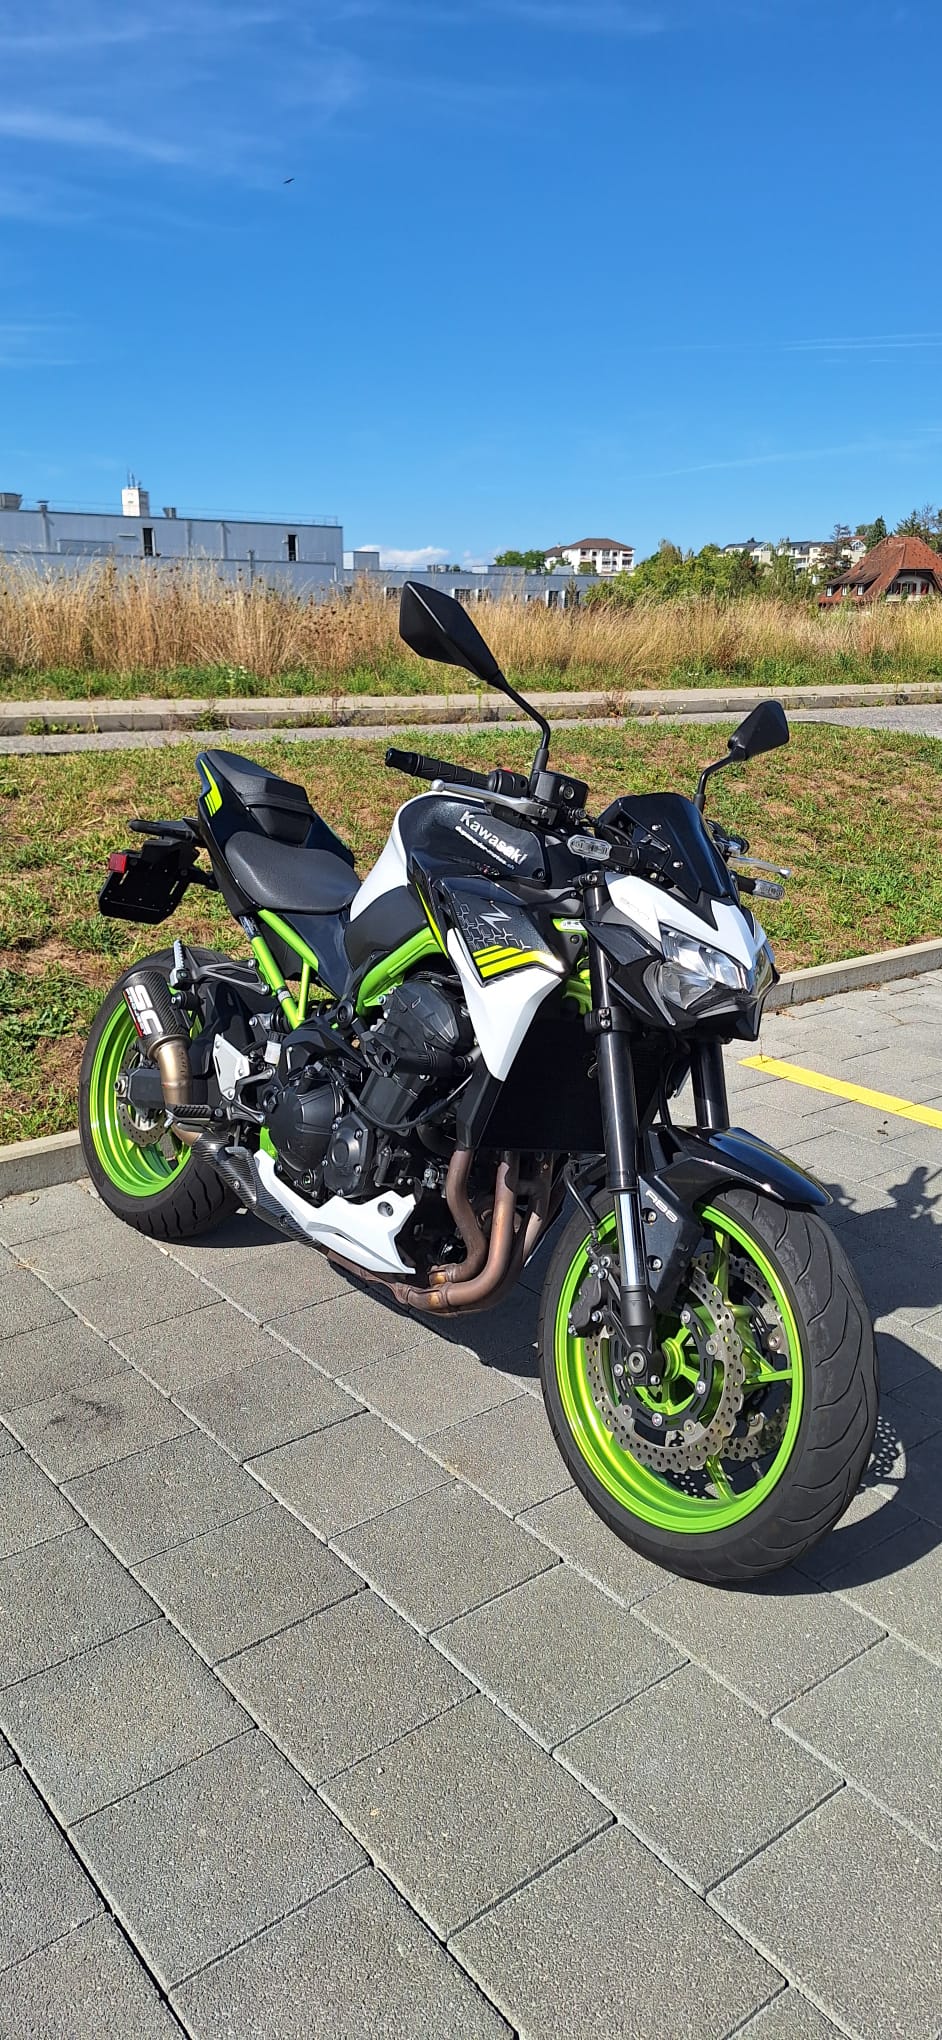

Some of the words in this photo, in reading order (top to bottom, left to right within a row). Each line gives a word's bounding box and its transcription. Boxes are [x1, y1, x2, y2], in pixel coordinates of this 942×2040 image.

[460, 810, 528, 865] Kawasaki
[125, 984, 163, 1036] SC
[645, 1190, 678, 1223] ABS
